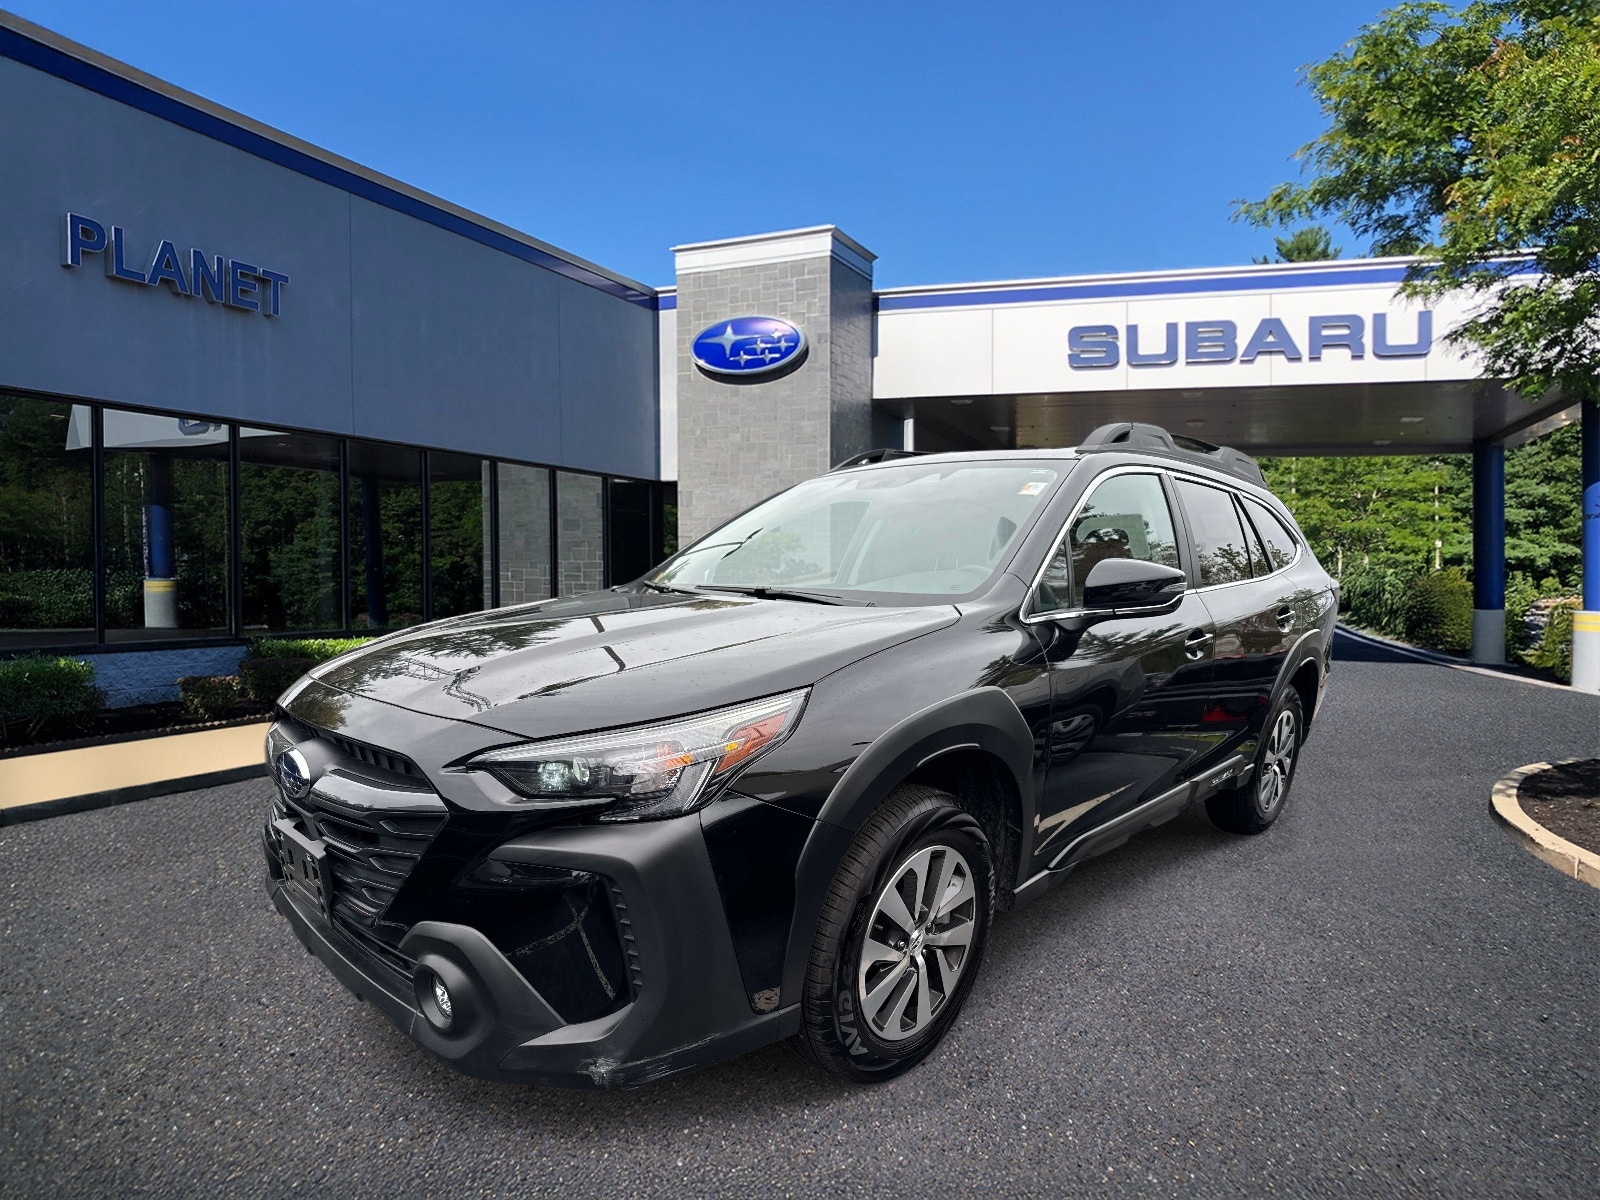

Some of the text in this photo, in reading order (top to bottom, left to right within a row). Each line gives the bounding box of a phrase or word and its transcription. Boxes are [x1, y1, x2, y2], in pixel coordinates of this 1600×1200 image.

[64, 212, 290, 317] PLANET
[1067, 310, 1433, 369] SUBARU
[838, 989, 869, 1056] AVID
